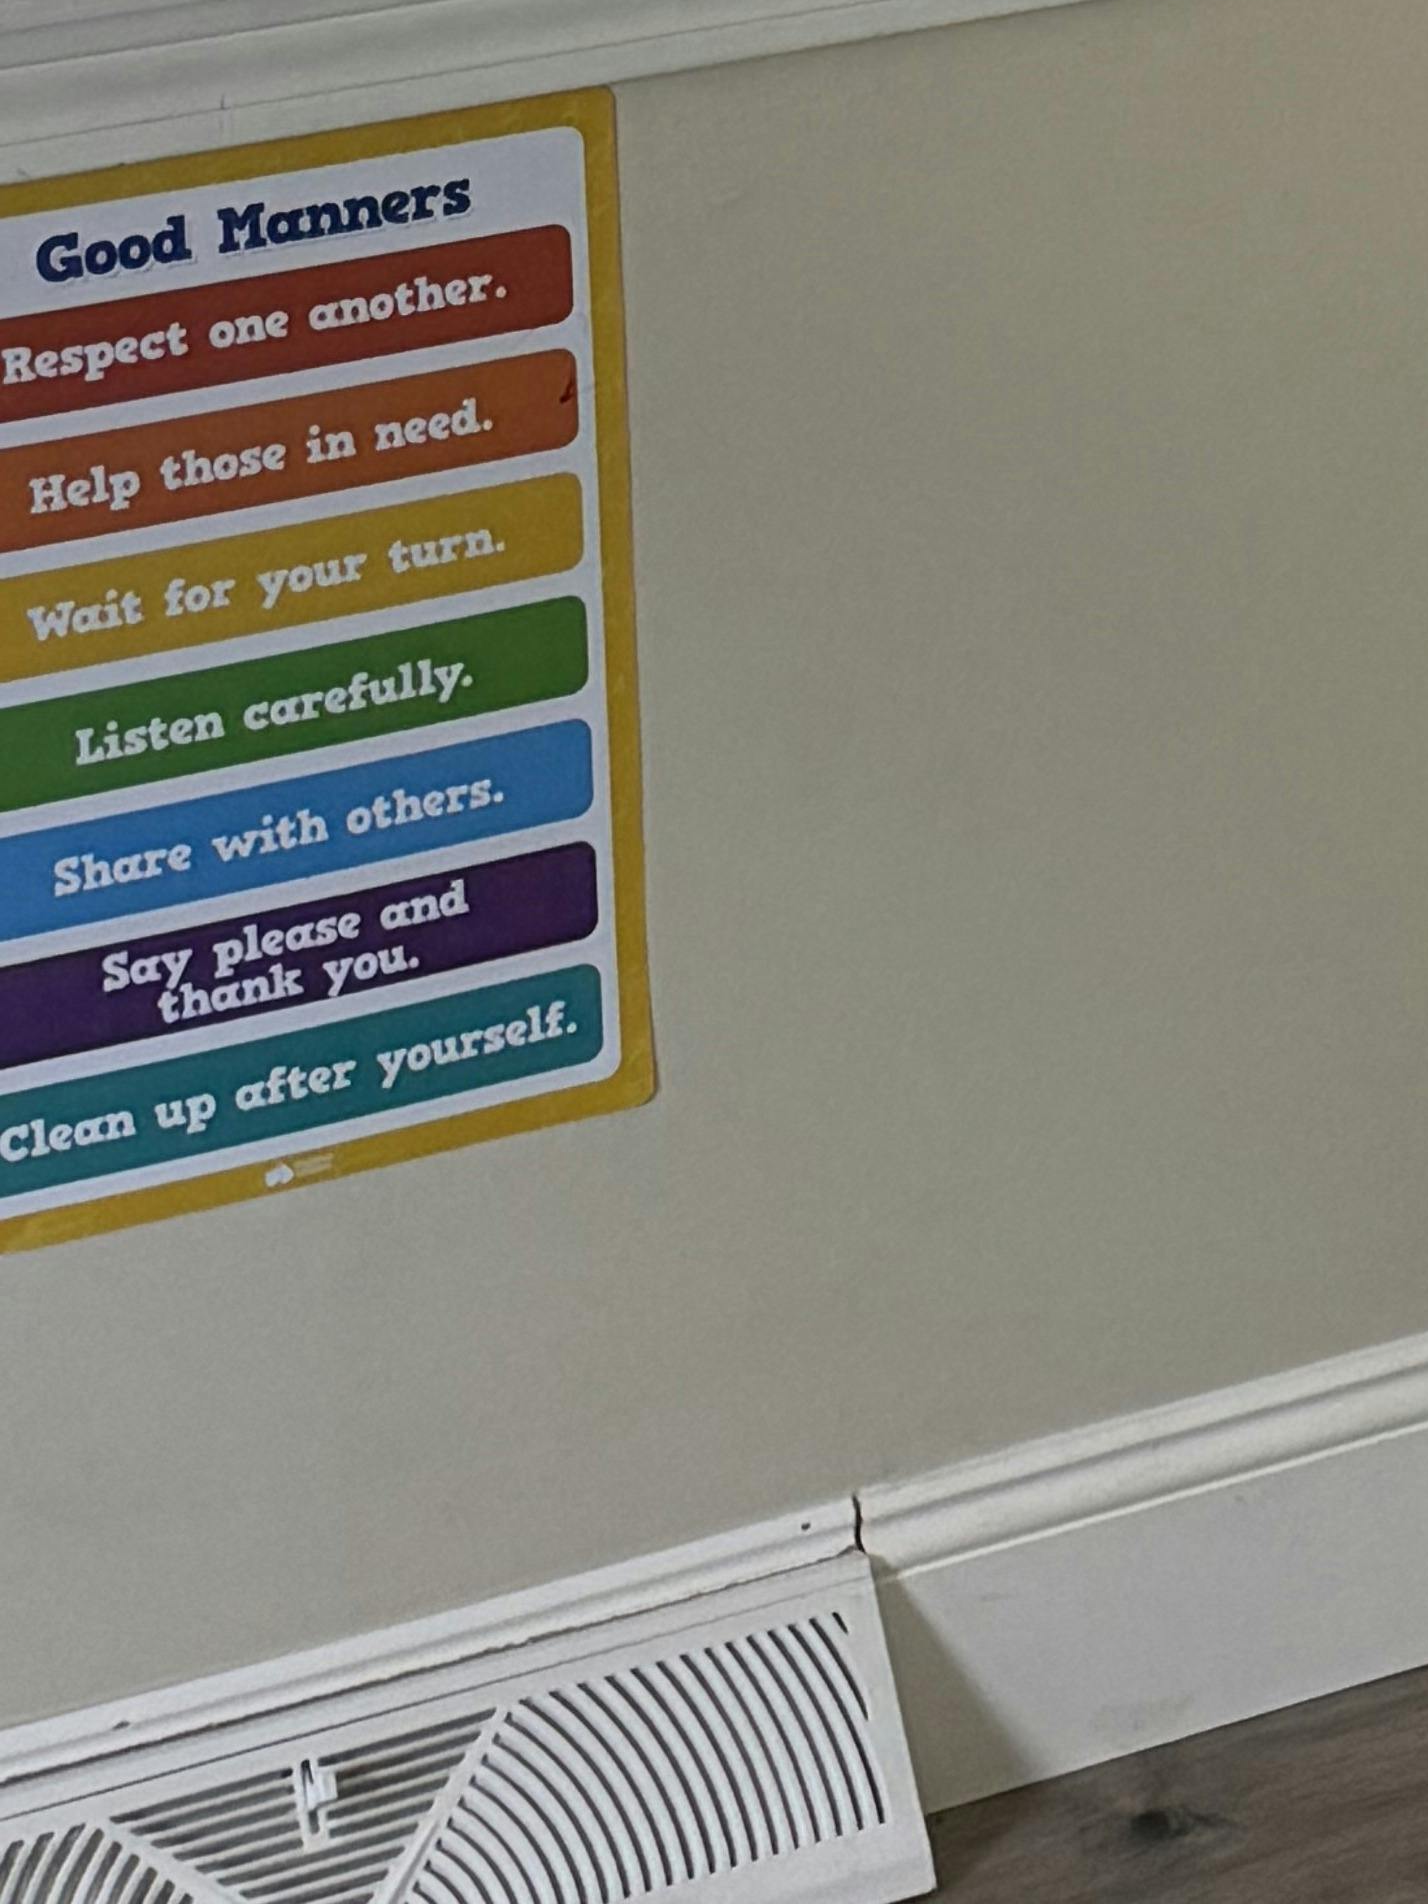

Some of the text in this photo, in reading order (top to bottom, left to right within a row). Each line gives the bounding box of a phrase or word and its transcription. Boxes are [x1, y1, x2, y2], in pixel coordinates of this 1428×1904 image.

[36, 179, 471, 282] Good Manners
[2, 273, 507, 384] Respect one another.
[30, 398, 493, 514] Help those in need.
[26, 527, 505, 642] Wait for your turn.
[75, 658, 473, 766] Listen carefully.
[53, 777, 503, 897] Share with others.
[102, 880, 469, 993] Say please and
[157, 947, 419, 1024] thank you.
[0, 1001, 577, 1162] Clean up after yourself.
